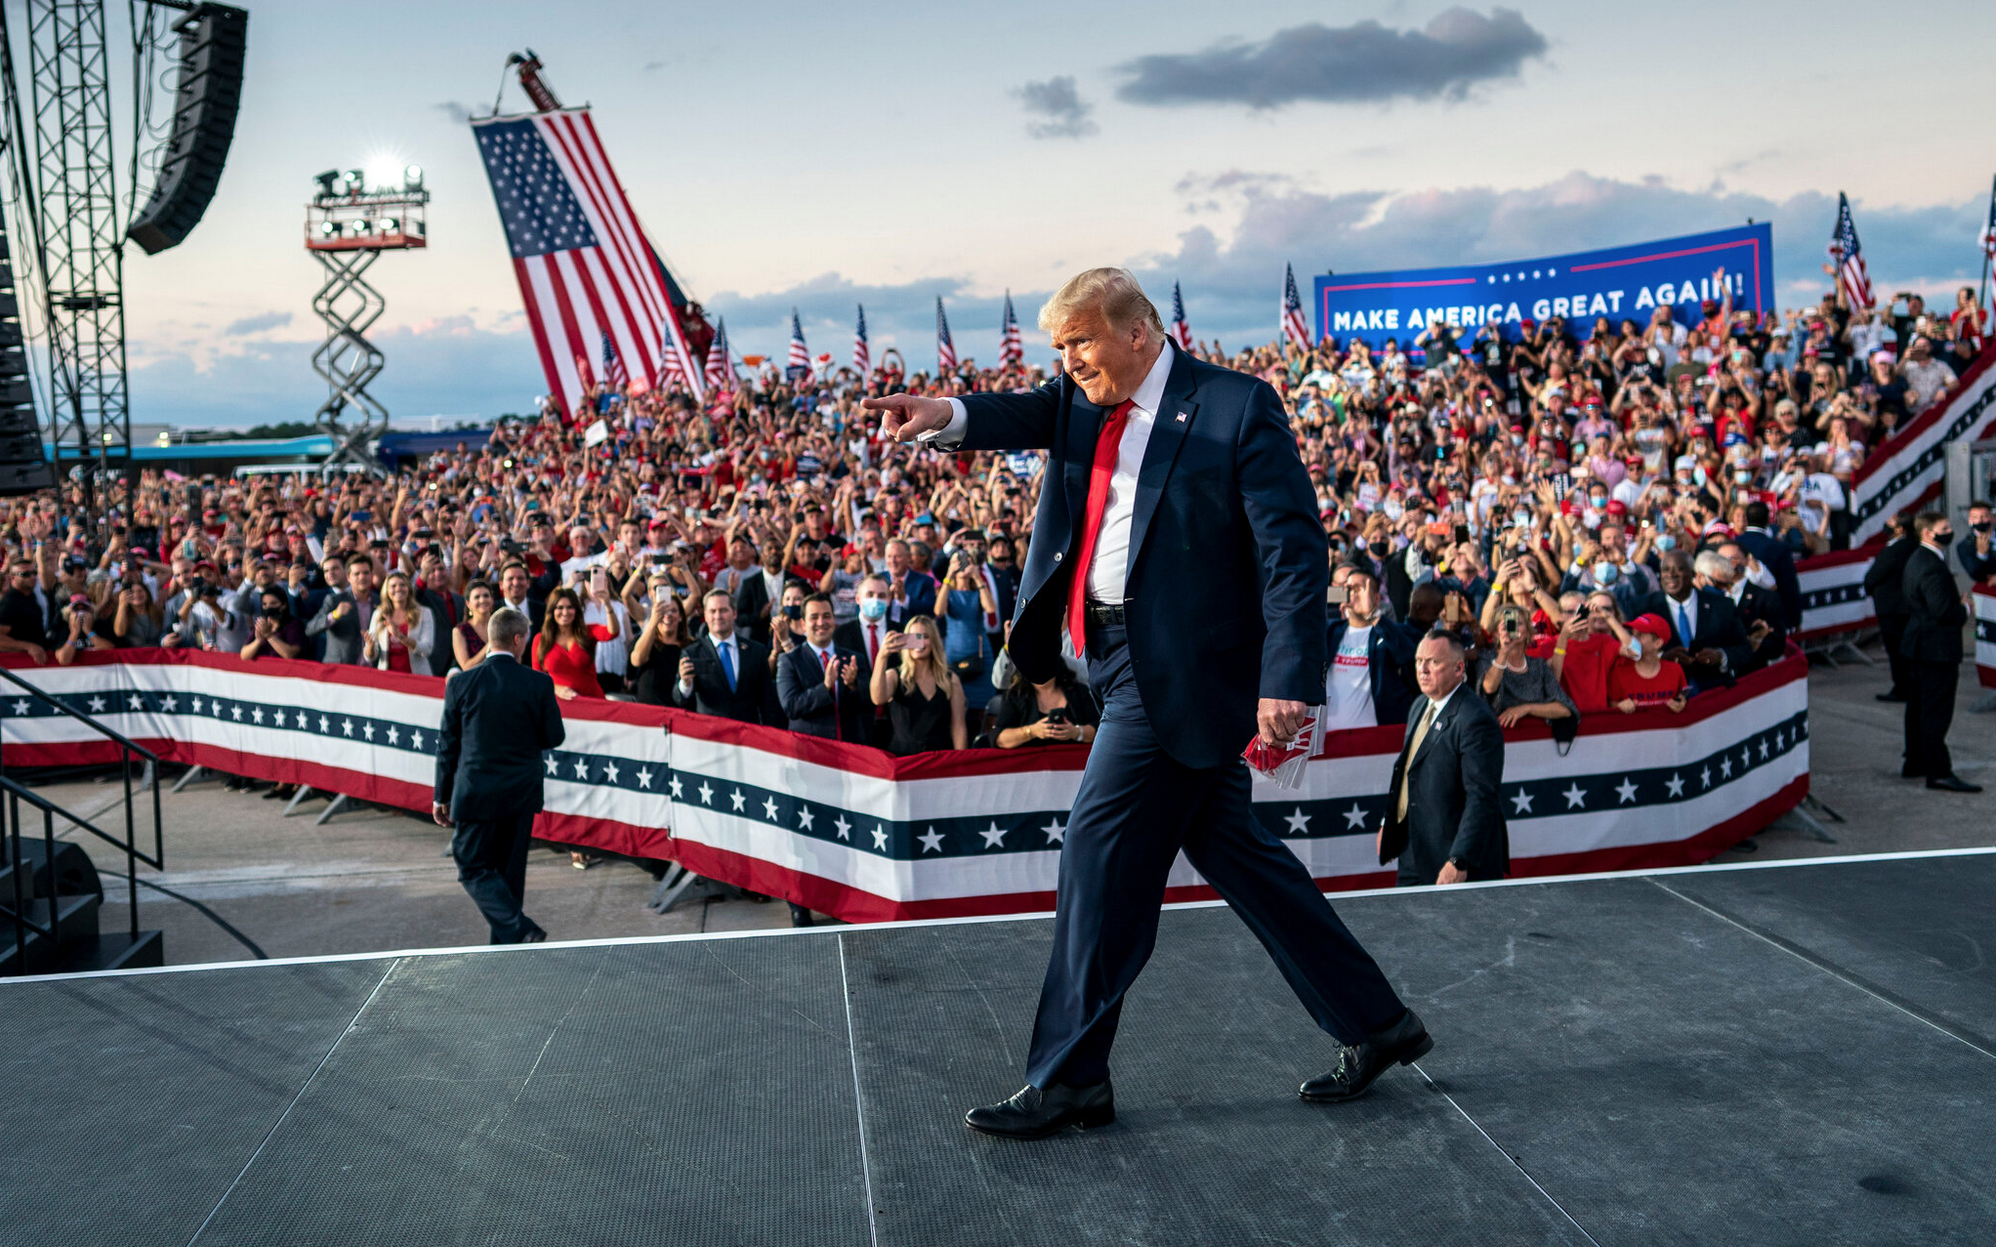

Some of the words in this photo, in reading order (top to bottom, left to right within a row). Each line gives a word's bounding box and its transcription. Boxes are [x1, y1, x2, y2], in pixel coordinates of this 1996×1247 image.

[1334, 309, 1399, 331] MAKE
[1407, 302, 1522, 329] AMERICA
[1532, 290, 1625, 321] GREAT
[1635, 273, 1743, 310] AGAIN!
[1340, 645, 1369, 657] tinos
